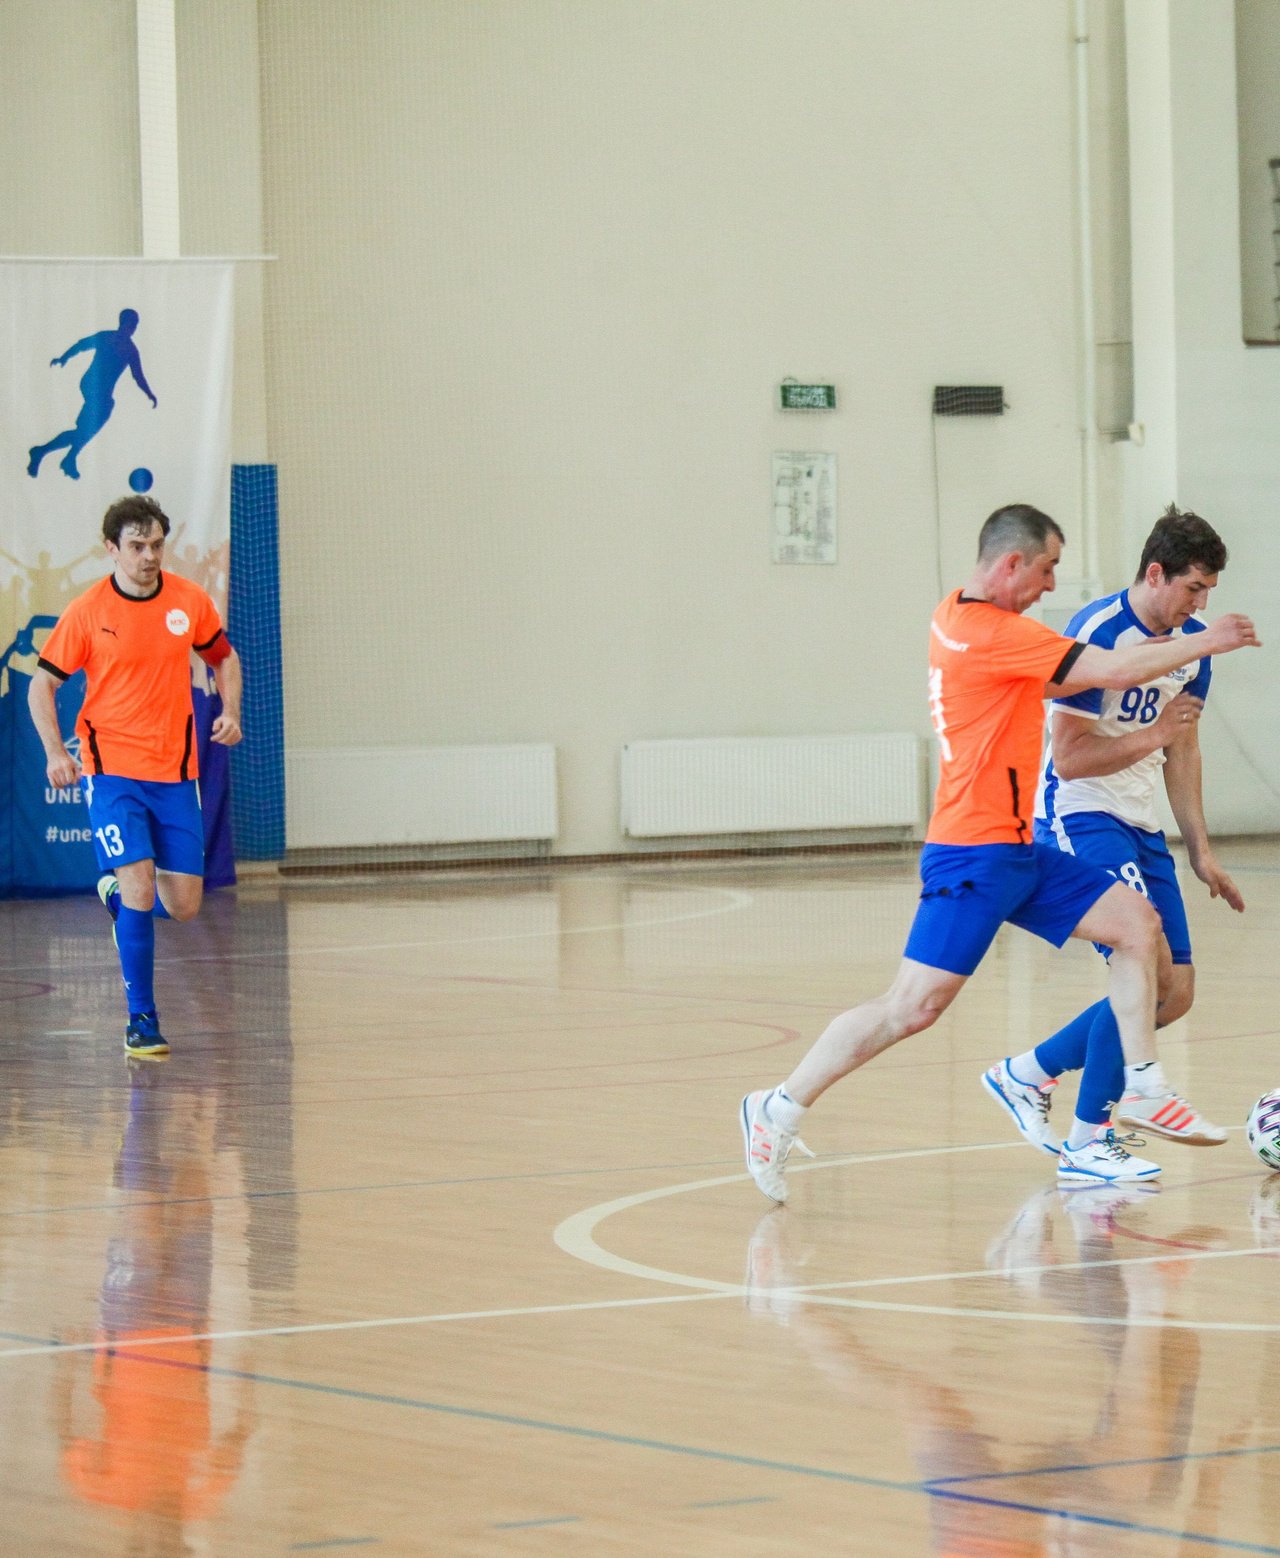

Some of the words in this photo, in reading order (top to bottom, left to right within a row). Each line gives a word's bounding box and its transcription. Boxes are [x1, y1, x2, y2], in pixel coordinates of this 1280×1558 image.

[1117, 686, 1160, 724] 98
[95, 824, 125, 858] 13
[1106, 862, 1148, 898] 8
